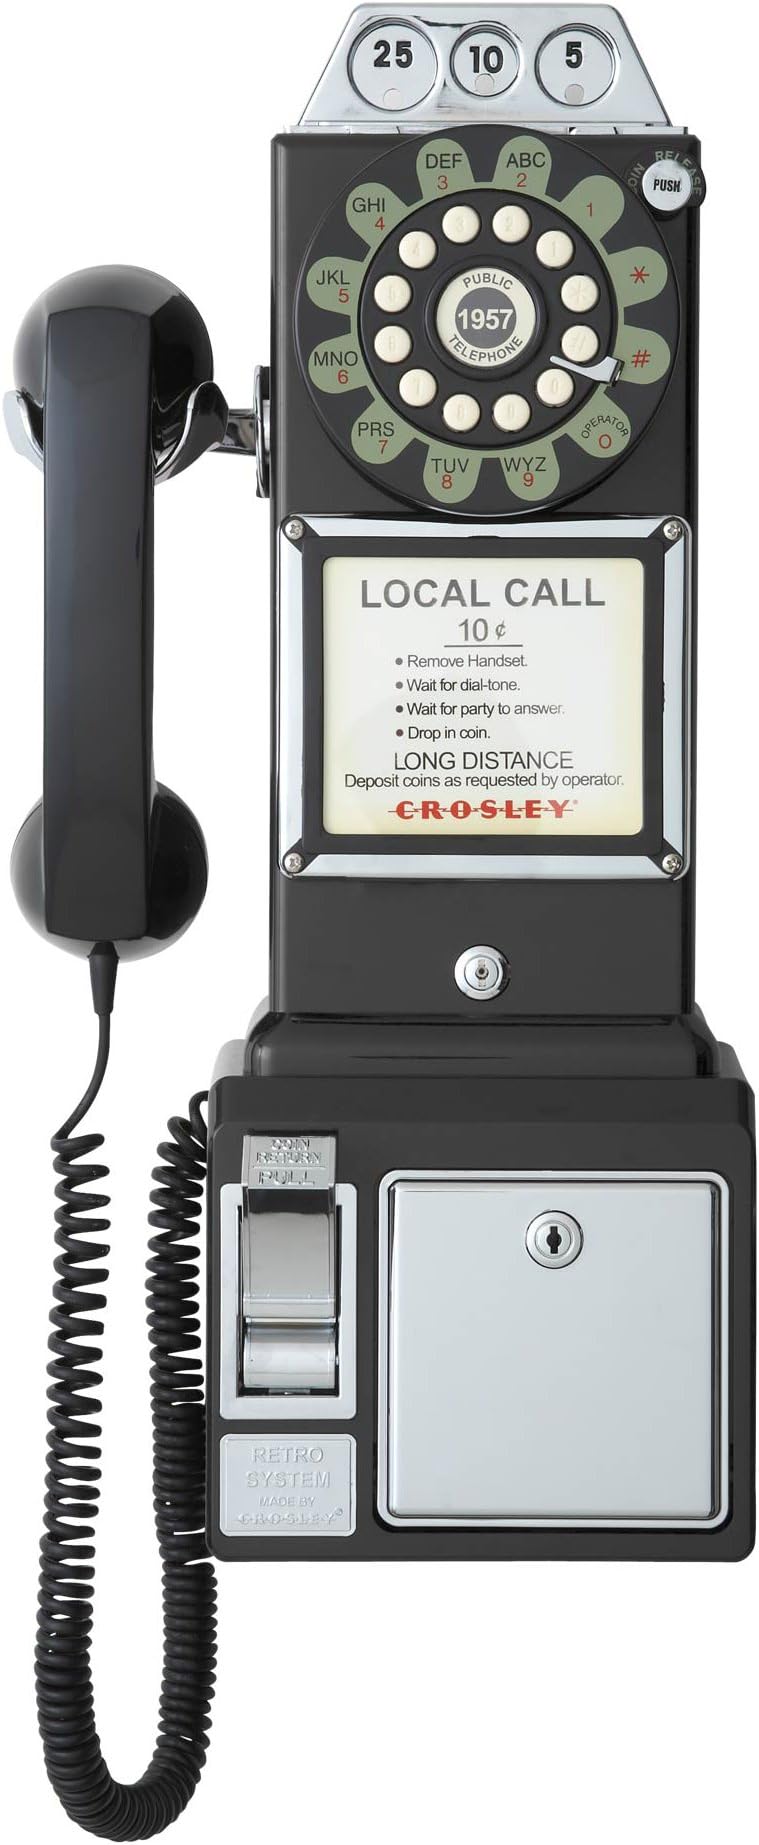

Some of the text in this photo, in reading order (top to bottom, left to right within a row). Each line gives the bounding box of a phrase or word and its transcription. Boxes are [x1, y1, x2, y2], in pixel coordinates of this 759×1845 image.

[373, 39, 413, 68] 25
[469, 46, 503, 74] 10
[565, 41, 583, 68] 5
[425, 153, 463, 169] DEF
[506, 151, 546, 168] ABC
[437, 175, 448, 190] 3
[516, 172, 527, 188] 2
[653, 178, 681, 193] PUSH
[352, 197, 386, 213] GHI
[586, 202, 593, 217] 1
[374, 216, 385, 231] 4
[316, 269, 350, 285] JKL
[463, 272, 513, 290] PUBLIC
[338, 288, 350, 303] 5
[458, 308, 514, 330] 1957
[448, 334, 523, 362] TELEPHONE
[313, 350, 358, 367] MNO
[337, 369, 349, 385] 6
[358, 421, 394, 437] PRS
[581, 415, 629, 439] OPERATOR
[378, 439, 388, 455] 7
[431, 458, 469, 474] TUV
[504, 457, 546, 472] WYZ
[441, 474, 453, 489] 8
[523, 472, 534, 487] 9
[361, 578, 606, 608] LOCAL CALL
[458, 617, 489, 642] 10
[407, 653, 528, 668] Remove Handset.
[407, 678, 521, 692] Wait for dial-tone.
[407, 702, 565, 719] Wait for party to answer.
[408, 726, 491, 742] Drop in coin.
[394, 751, 574, 770] LONG DISTANCE
[345, 773, 625, 791] Deposit coins as requested by operator.
[258, 1170, 315, 1185] PULL
[252, 1447, 324, 1464] RETRO
[246, 1471, 330, 1488] SYSTEM
[259, 1496, 316, 1507] MADE BY
